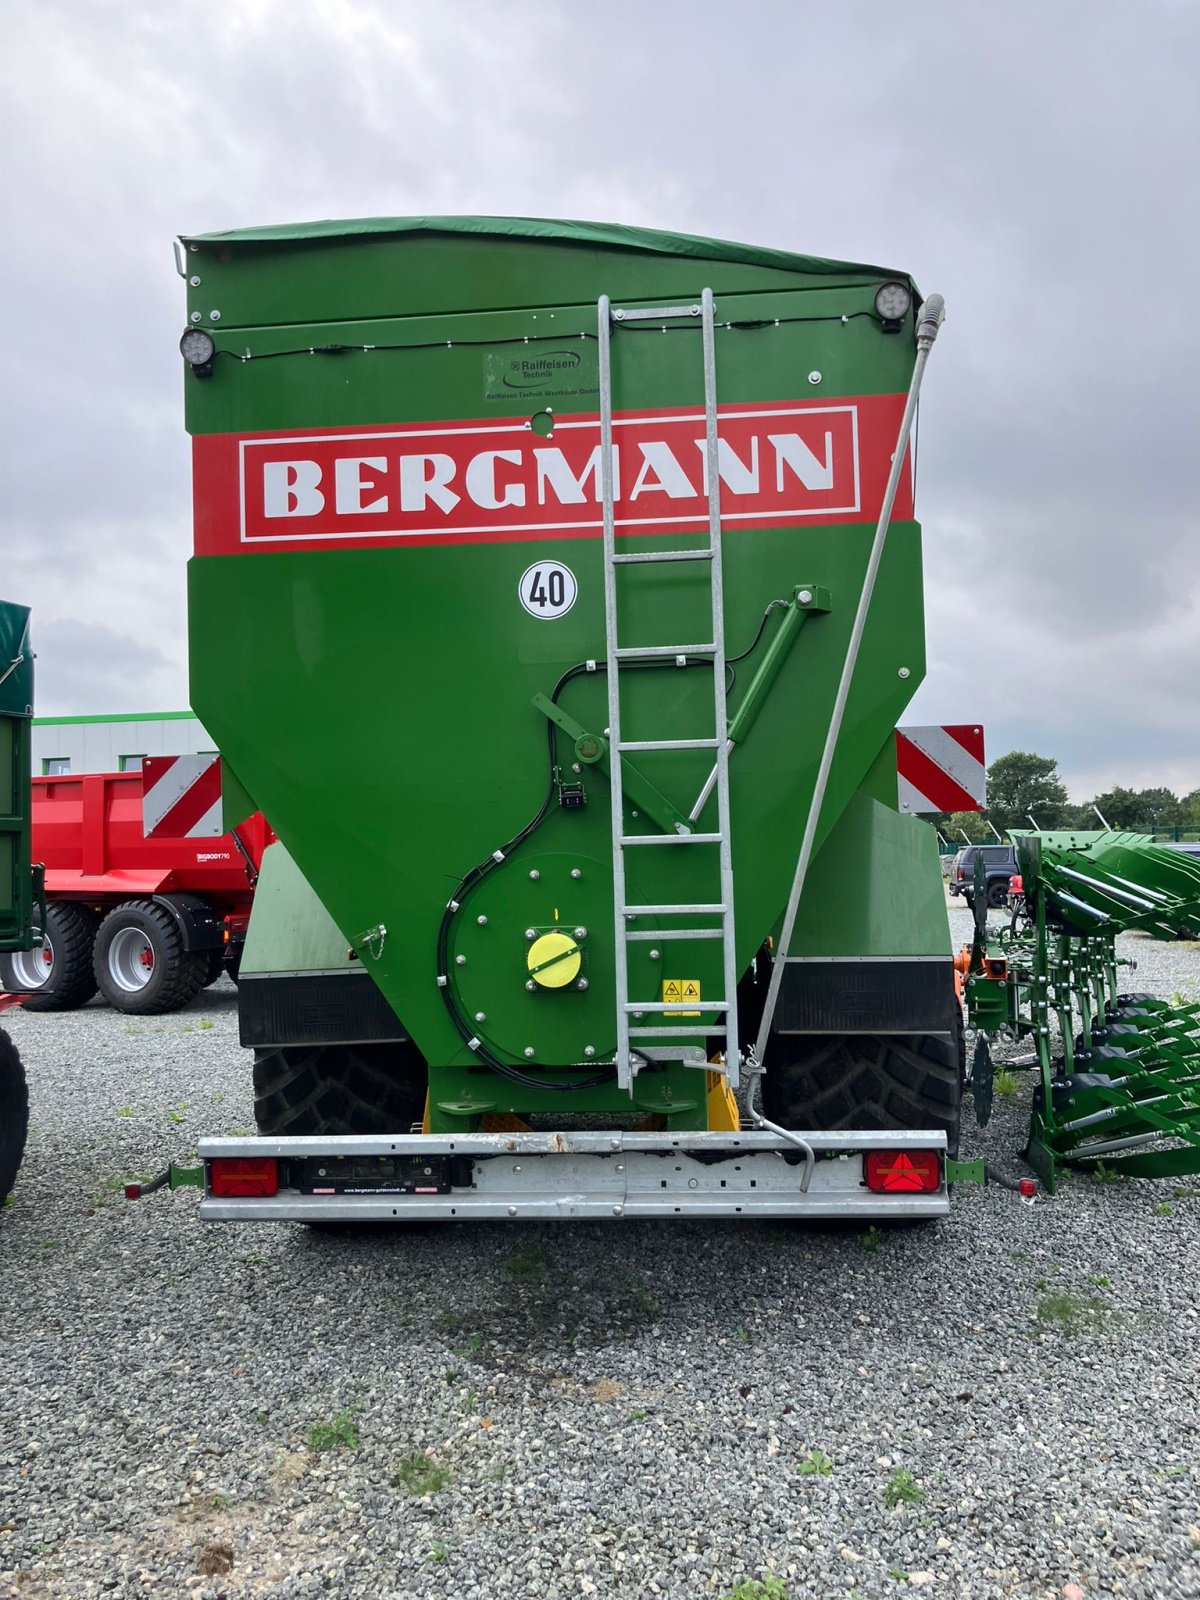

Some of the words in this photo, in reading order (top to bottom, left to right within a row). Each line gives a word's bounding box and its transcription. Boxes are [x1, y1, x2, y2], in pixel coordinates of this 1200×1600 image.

[521, 360, 575, 370] Raiffeisen
[523, 370, 553, 379] Technik
[263, 431, 834, 517] BERGMANN
[529, 570, 565, 608] 40
